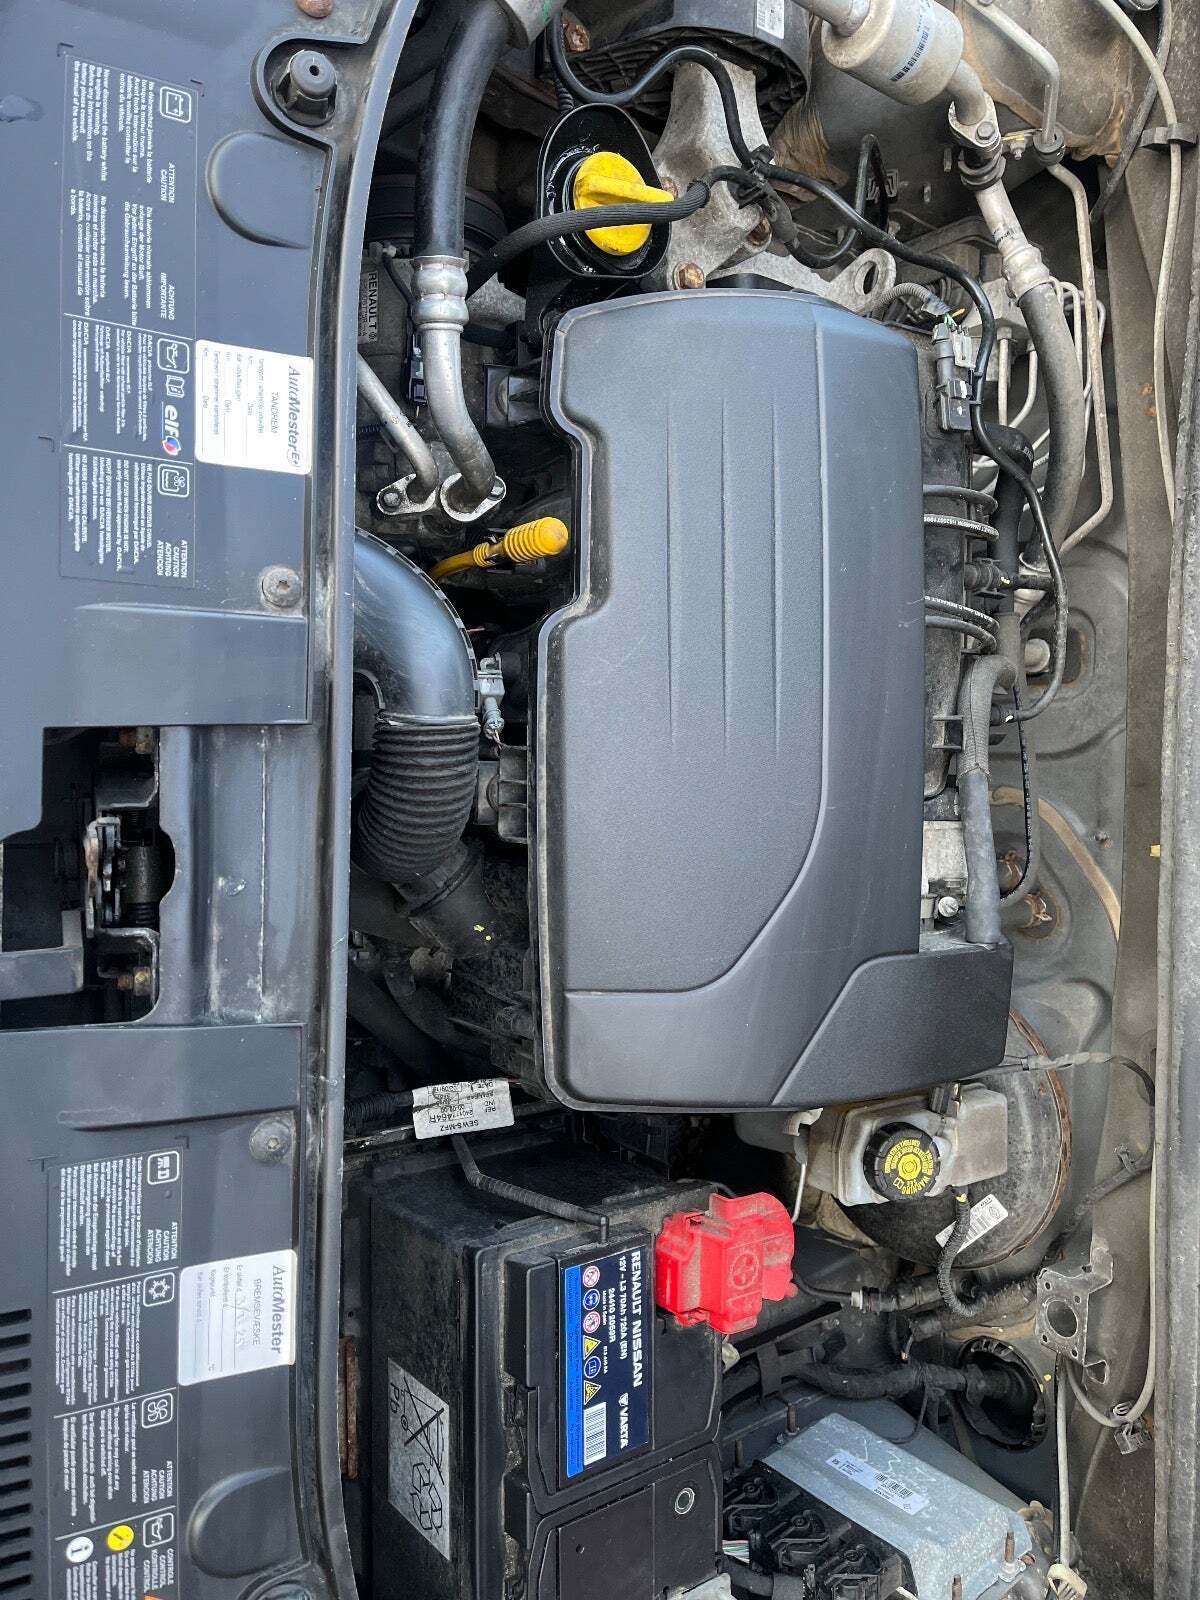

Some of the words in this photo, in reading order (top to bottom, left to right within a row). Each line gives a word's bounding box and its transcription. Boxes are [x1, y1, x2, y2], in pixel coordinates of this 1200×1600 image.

[369, 273, 377, 329] RENAULT
[164, 404, 179, 438] elf
[287, 366, 301, 450] AutoMester
[253, 1279, 261, 1345] BREMSEVÆSKE
[271, 1265, 285, 1353] AutoMester
[620, 1283, 626, 1291] L3
[632, 1251, 641, 1315] RENAULT
[633, 1320, 642, 1387] NISSAN
[390, 1382, 400, 1413] Pb
[620, 1407, 628, 1449] VARTA
